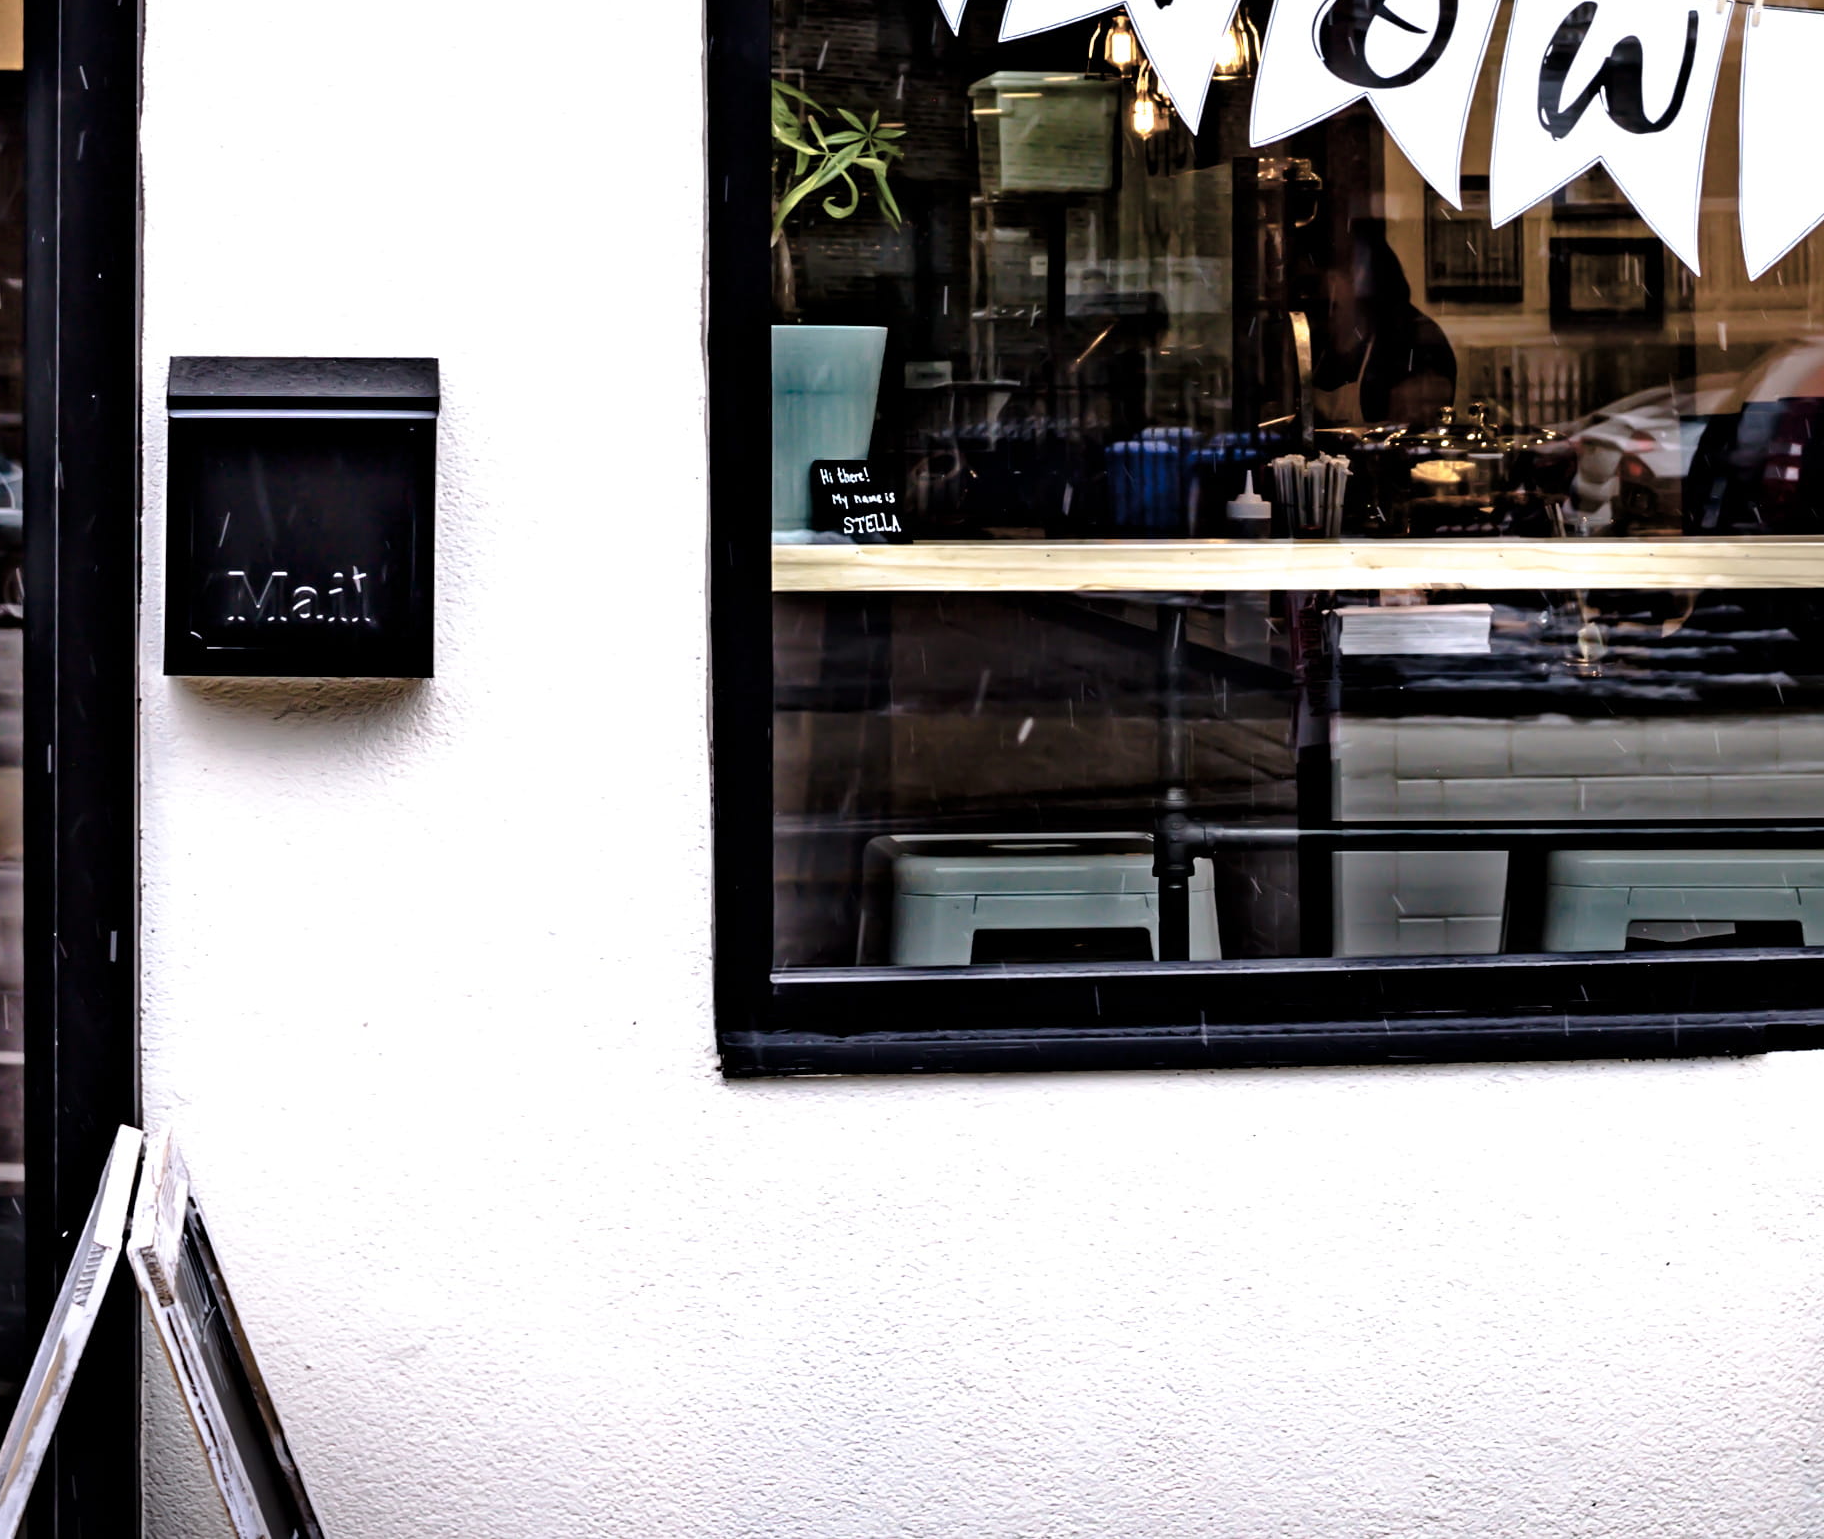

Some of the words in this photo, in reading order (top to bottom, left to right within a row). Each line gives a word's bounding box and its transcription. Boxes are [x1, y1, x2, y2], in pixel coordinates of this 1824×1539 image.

[819, 468, 834, 485] Hi
[836, 466, 871, 484] there!
[831, 493, 849, 510] My
[853, 494, 883, 504] name
[884, 492, 896, 504] is
[843, 512, 902, 534] STELLA
